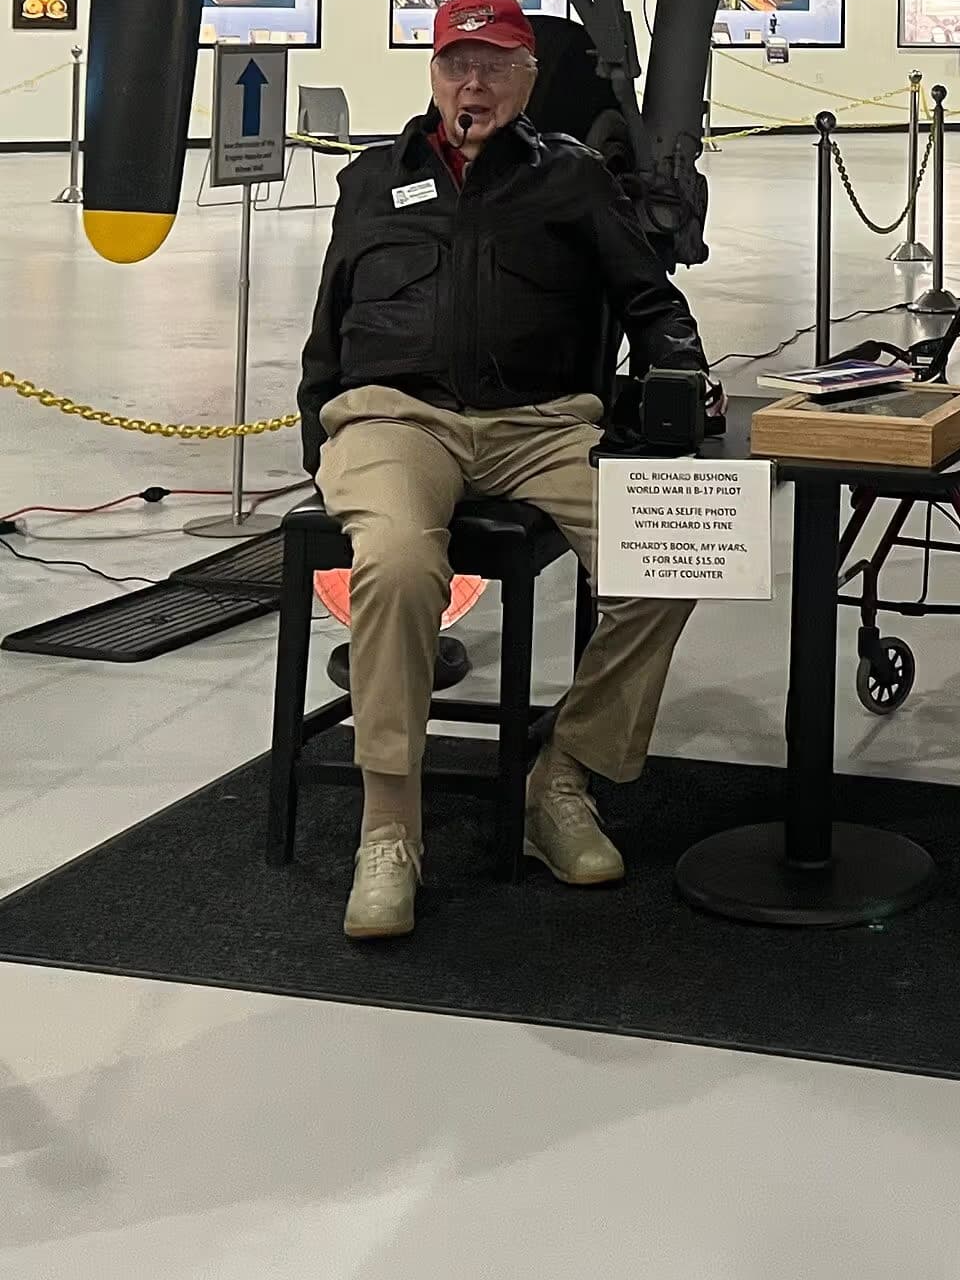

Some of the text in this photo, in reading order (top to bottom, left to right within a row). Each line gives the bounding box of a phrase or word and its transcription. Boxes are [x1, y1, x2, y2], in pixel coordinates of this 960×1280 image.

[651, 472, 691, 481] RICHARD
[693, 473, 738, 482] BUSHONG
[626, 486, 741, 496] WORLD WAR II B-17 PILOT
[631, 506, 737, 517] TAKING A SELFIE PHOTO
[634, 520, 733, 530] WITH RICHARD IS FINE
[620, 541, 748, 553] RICHARD'S BOOK, MY WARS,
[642, 555, 651, 564] IS
[652, 555, 671, 565] FOR
[672, 555, 693, 565] SALE
[644, 569, 724, 580] AT GIFT COUNTER
